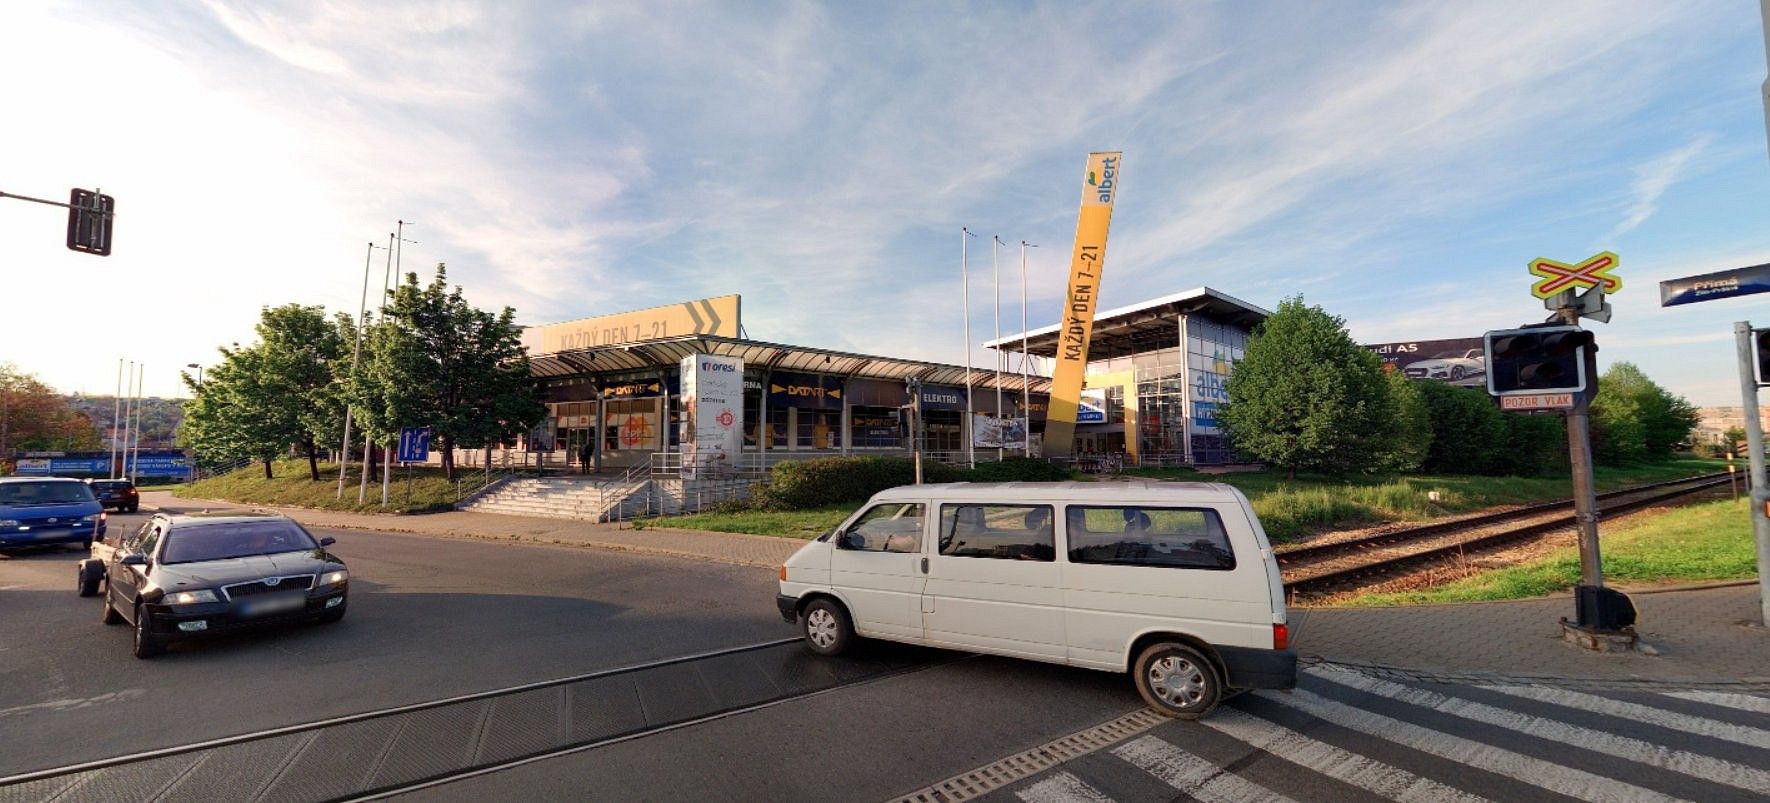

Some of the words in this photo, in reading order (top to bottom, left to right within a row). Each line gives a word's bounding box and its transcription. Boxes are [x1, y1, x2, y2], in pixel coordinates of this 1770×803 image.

[1098, 157, 1117, 202] albert
[1073, 284, 1092, 313] DEN
[603, 326, 629, 344] DEN
[1065, 317, 1087, 361] KAŽDÝ
[1369, 345, 1391, 354] udi
[1397, 343, 1418, 353] A5
[711, 362, 736, 373] oresi
[743, 381, 762, 390] RNA
[1196, 371, 1229, 399] albe
[923, 393, 957, 404] ELEKTRO
[1505, 396, 1537, 408] POZOR
[1545, 394, 1569, 405] VLAK
